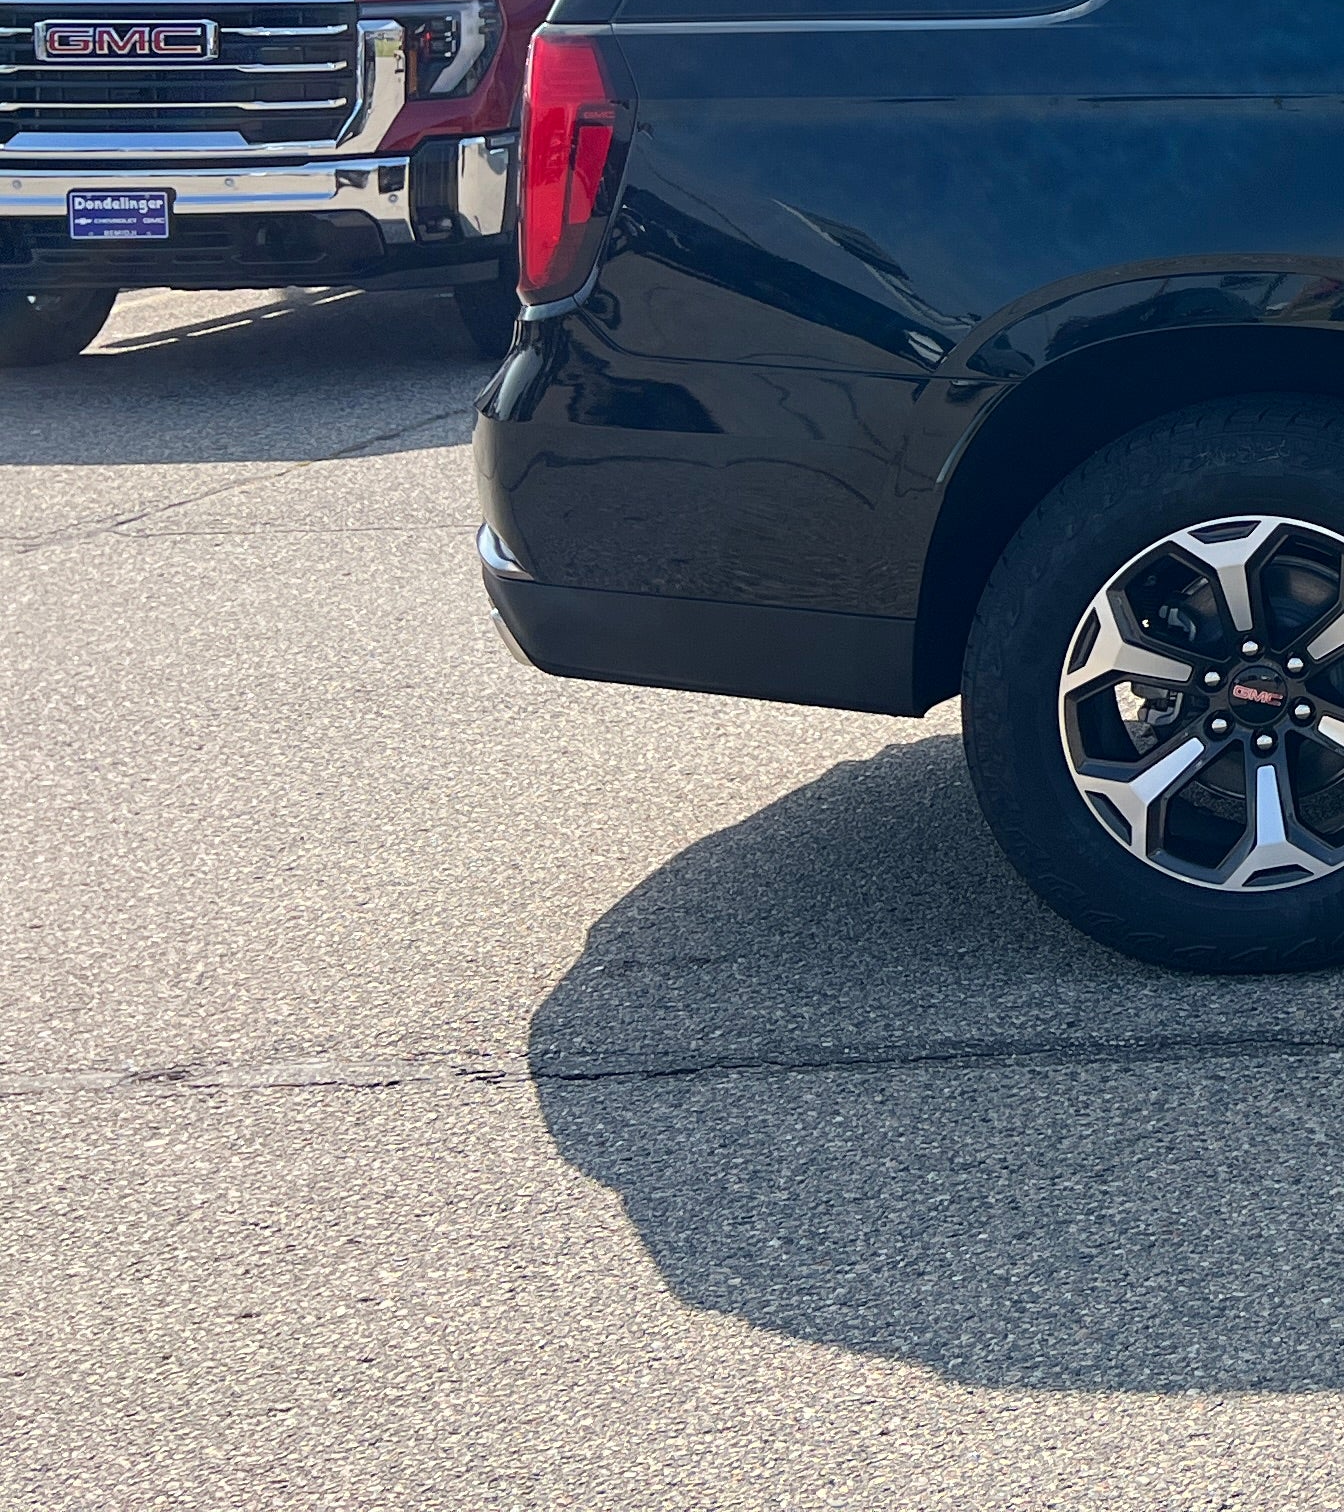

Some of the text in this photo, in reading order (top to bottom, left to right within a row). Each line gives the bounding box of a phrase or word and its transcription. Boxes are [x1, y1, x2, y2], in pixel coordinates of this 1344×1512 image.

[46, 27, 202, 55] GMC
[73, 196, 164, 214] Dondelinger
[1232, 684, 1284, 707] GMC
